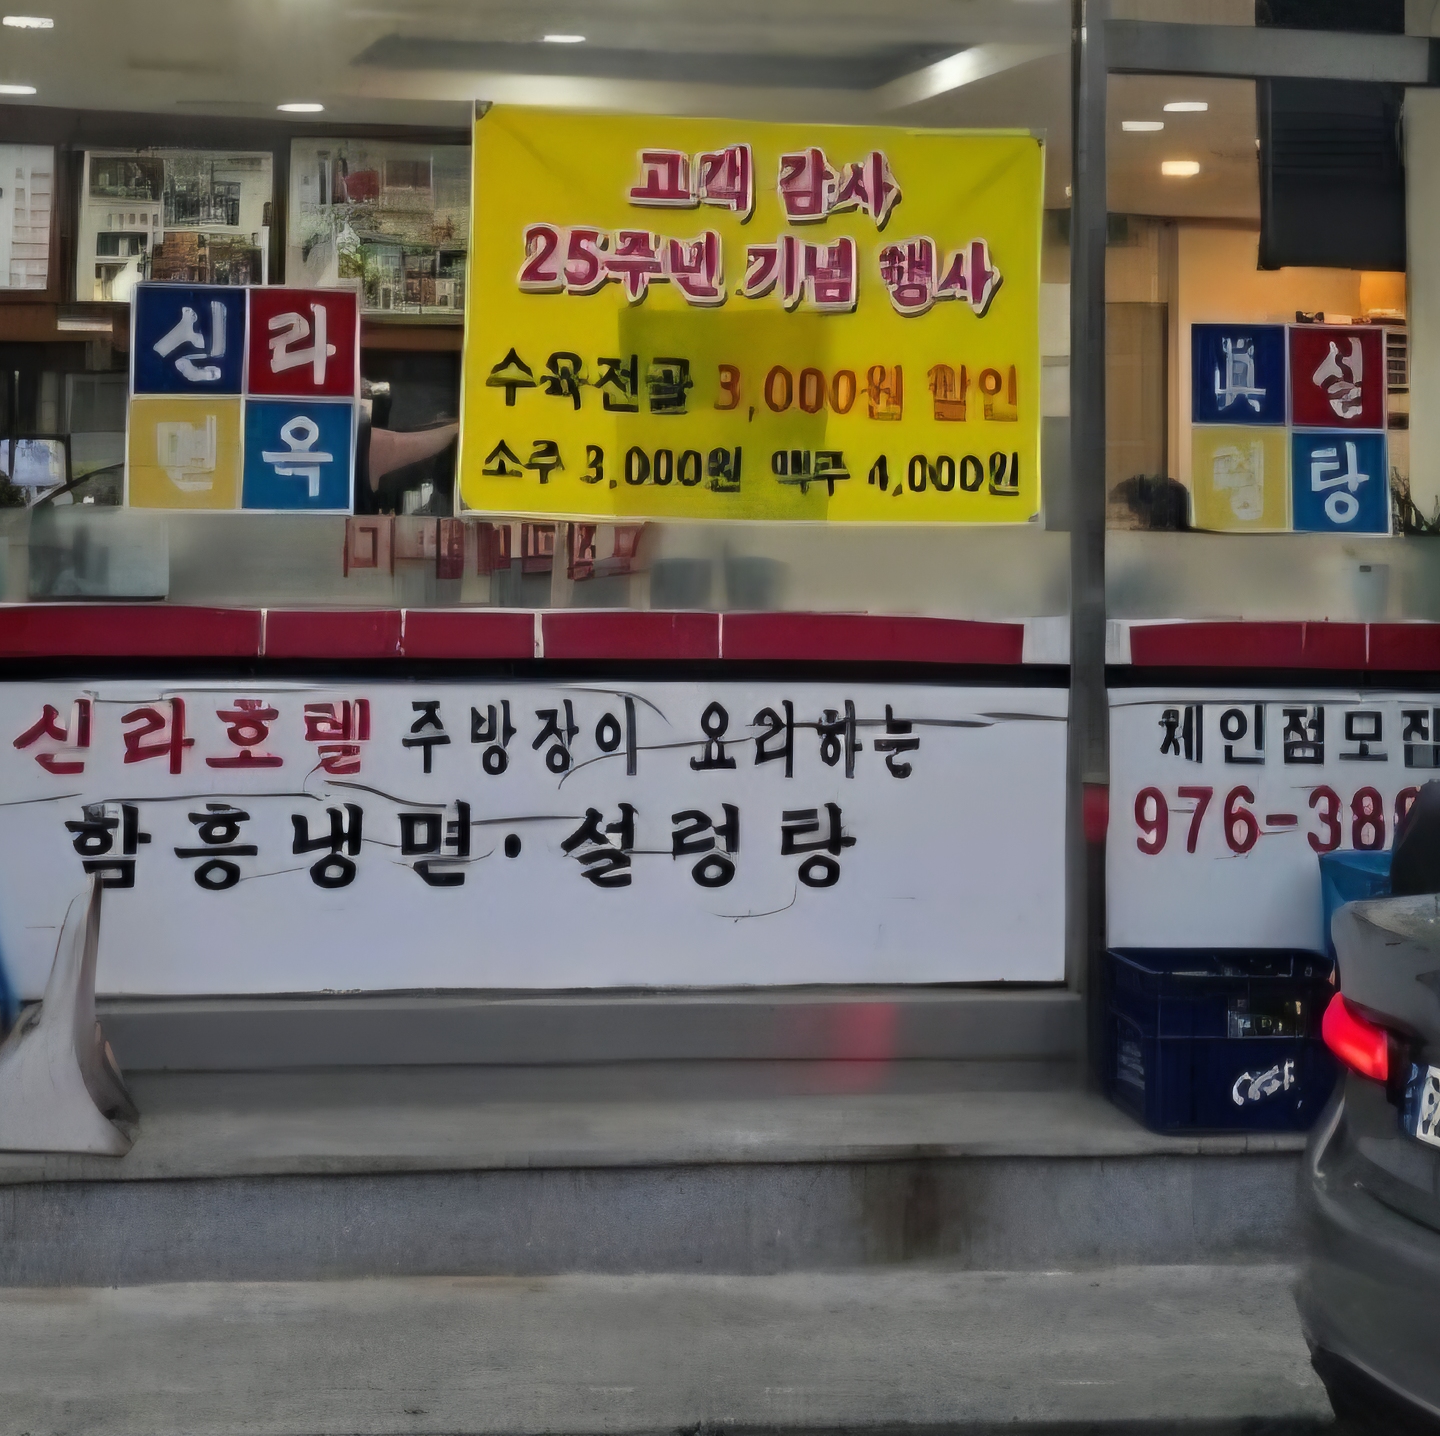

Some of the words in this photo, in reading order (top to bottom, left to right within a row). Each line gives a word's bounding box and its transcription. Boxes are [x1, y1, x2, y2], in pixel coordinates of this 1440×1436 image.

[628, 143, 754, 224] 고객
[778, 147, 902, 231] 감사
[517, 222, 728, 308] 25주년
[737, 233, 859, 314] 기념
[879, 235, 1002, 319] 행사
[152, 300, 337, 386] 신라
[12, 696, 372, 776] 신라호텔
[402, 693, 638, 778] 주방장이
[689, 698, 921, 781] 요리하는
